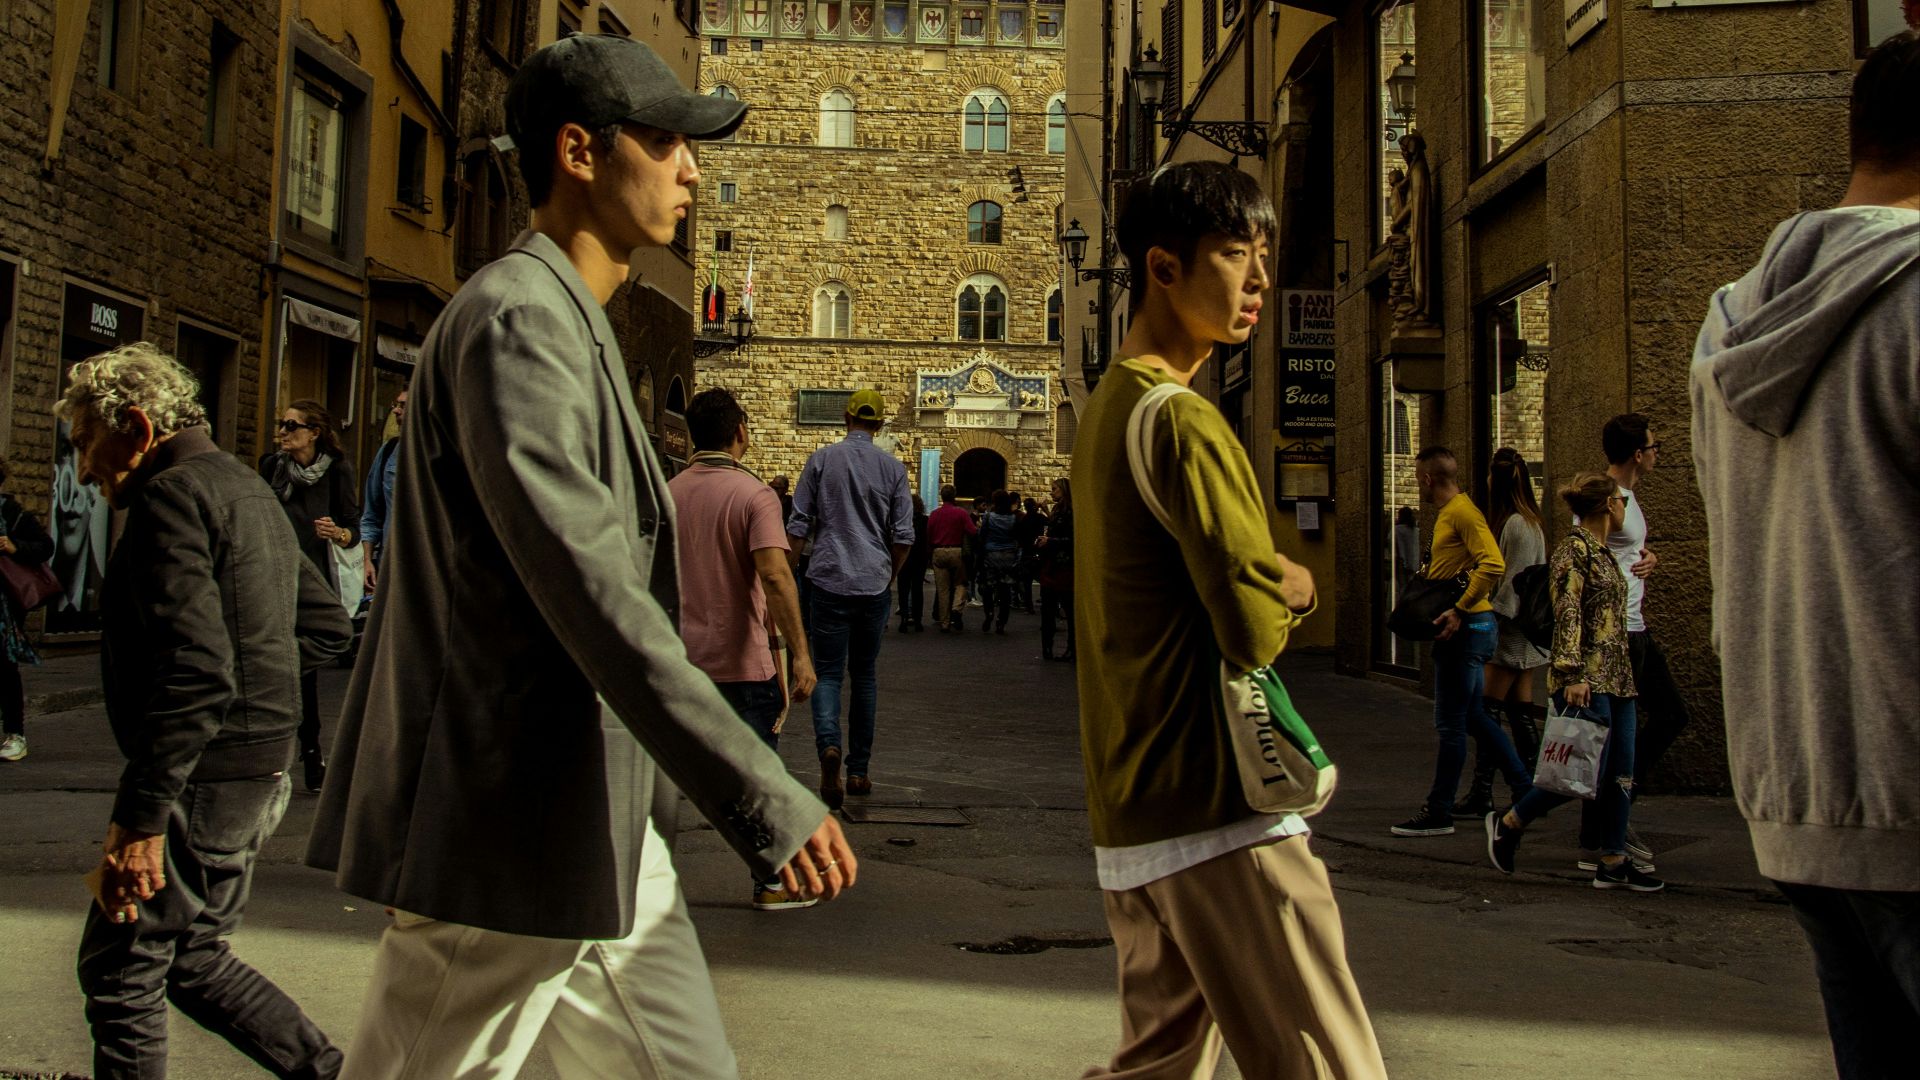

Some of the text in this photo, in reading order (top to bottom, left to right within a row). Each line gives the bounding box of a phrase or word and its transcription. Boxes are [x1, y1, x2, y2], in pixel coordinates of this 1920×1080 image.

[90, 302, 118, 330] BOSS
[1288, 358, 1336, 372] RISTO
[1285, 385, 1330, 405] Buca
